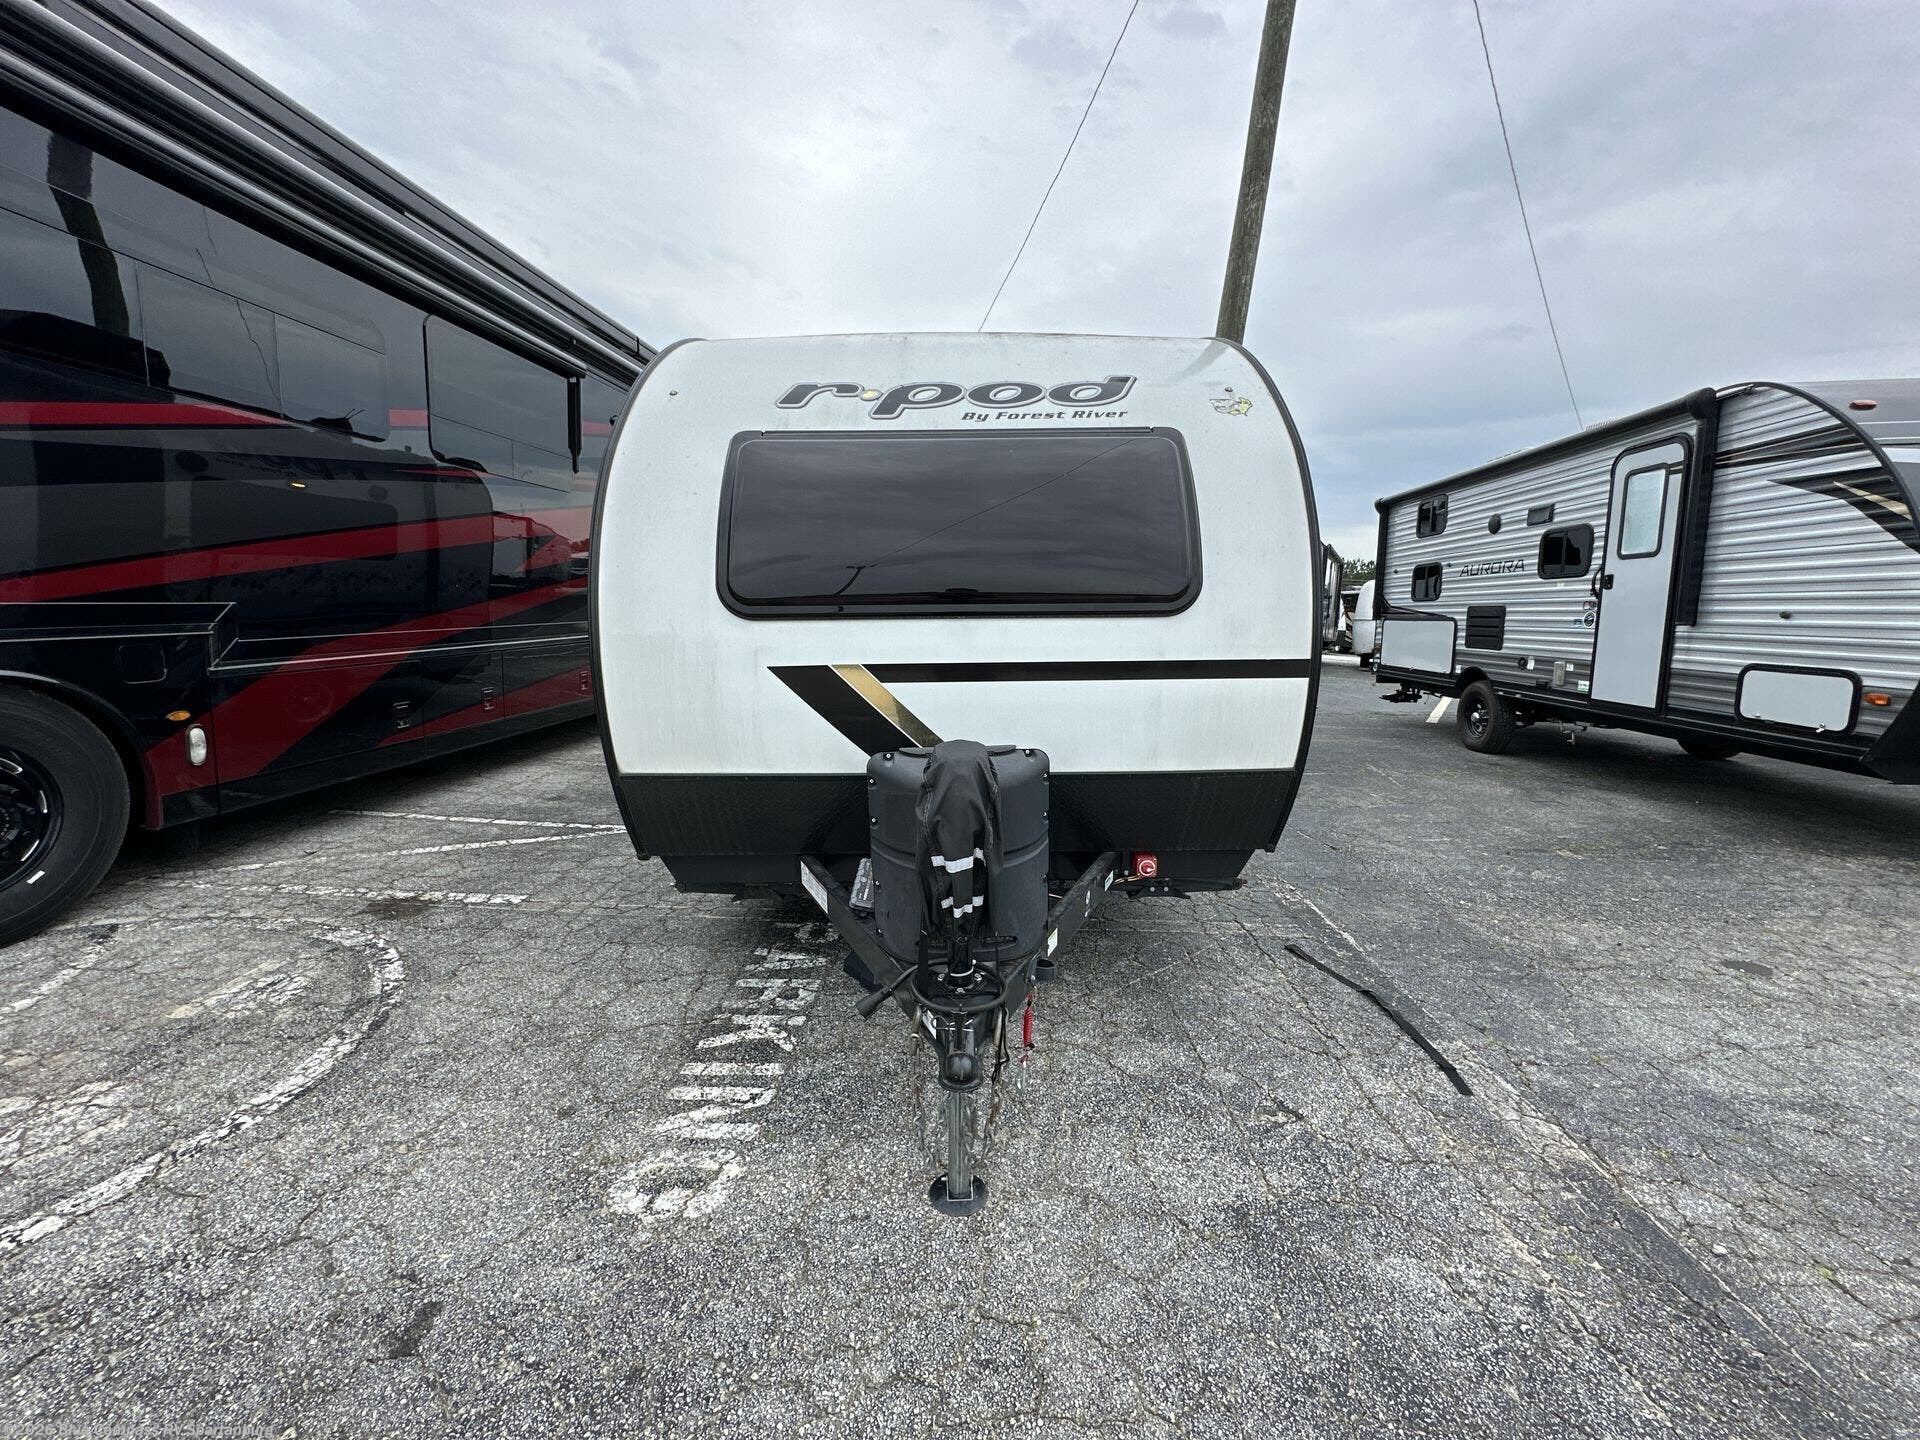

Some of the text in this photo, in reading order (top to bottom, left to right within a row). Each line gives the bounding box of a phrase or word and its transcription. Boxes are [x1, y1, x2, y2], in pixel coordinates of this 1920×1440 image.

[961, 409, 1128, 423] By Forest River
[1459, 559, 1526, 577] AURORA
[606, 922, 840, 1219] PARKING
